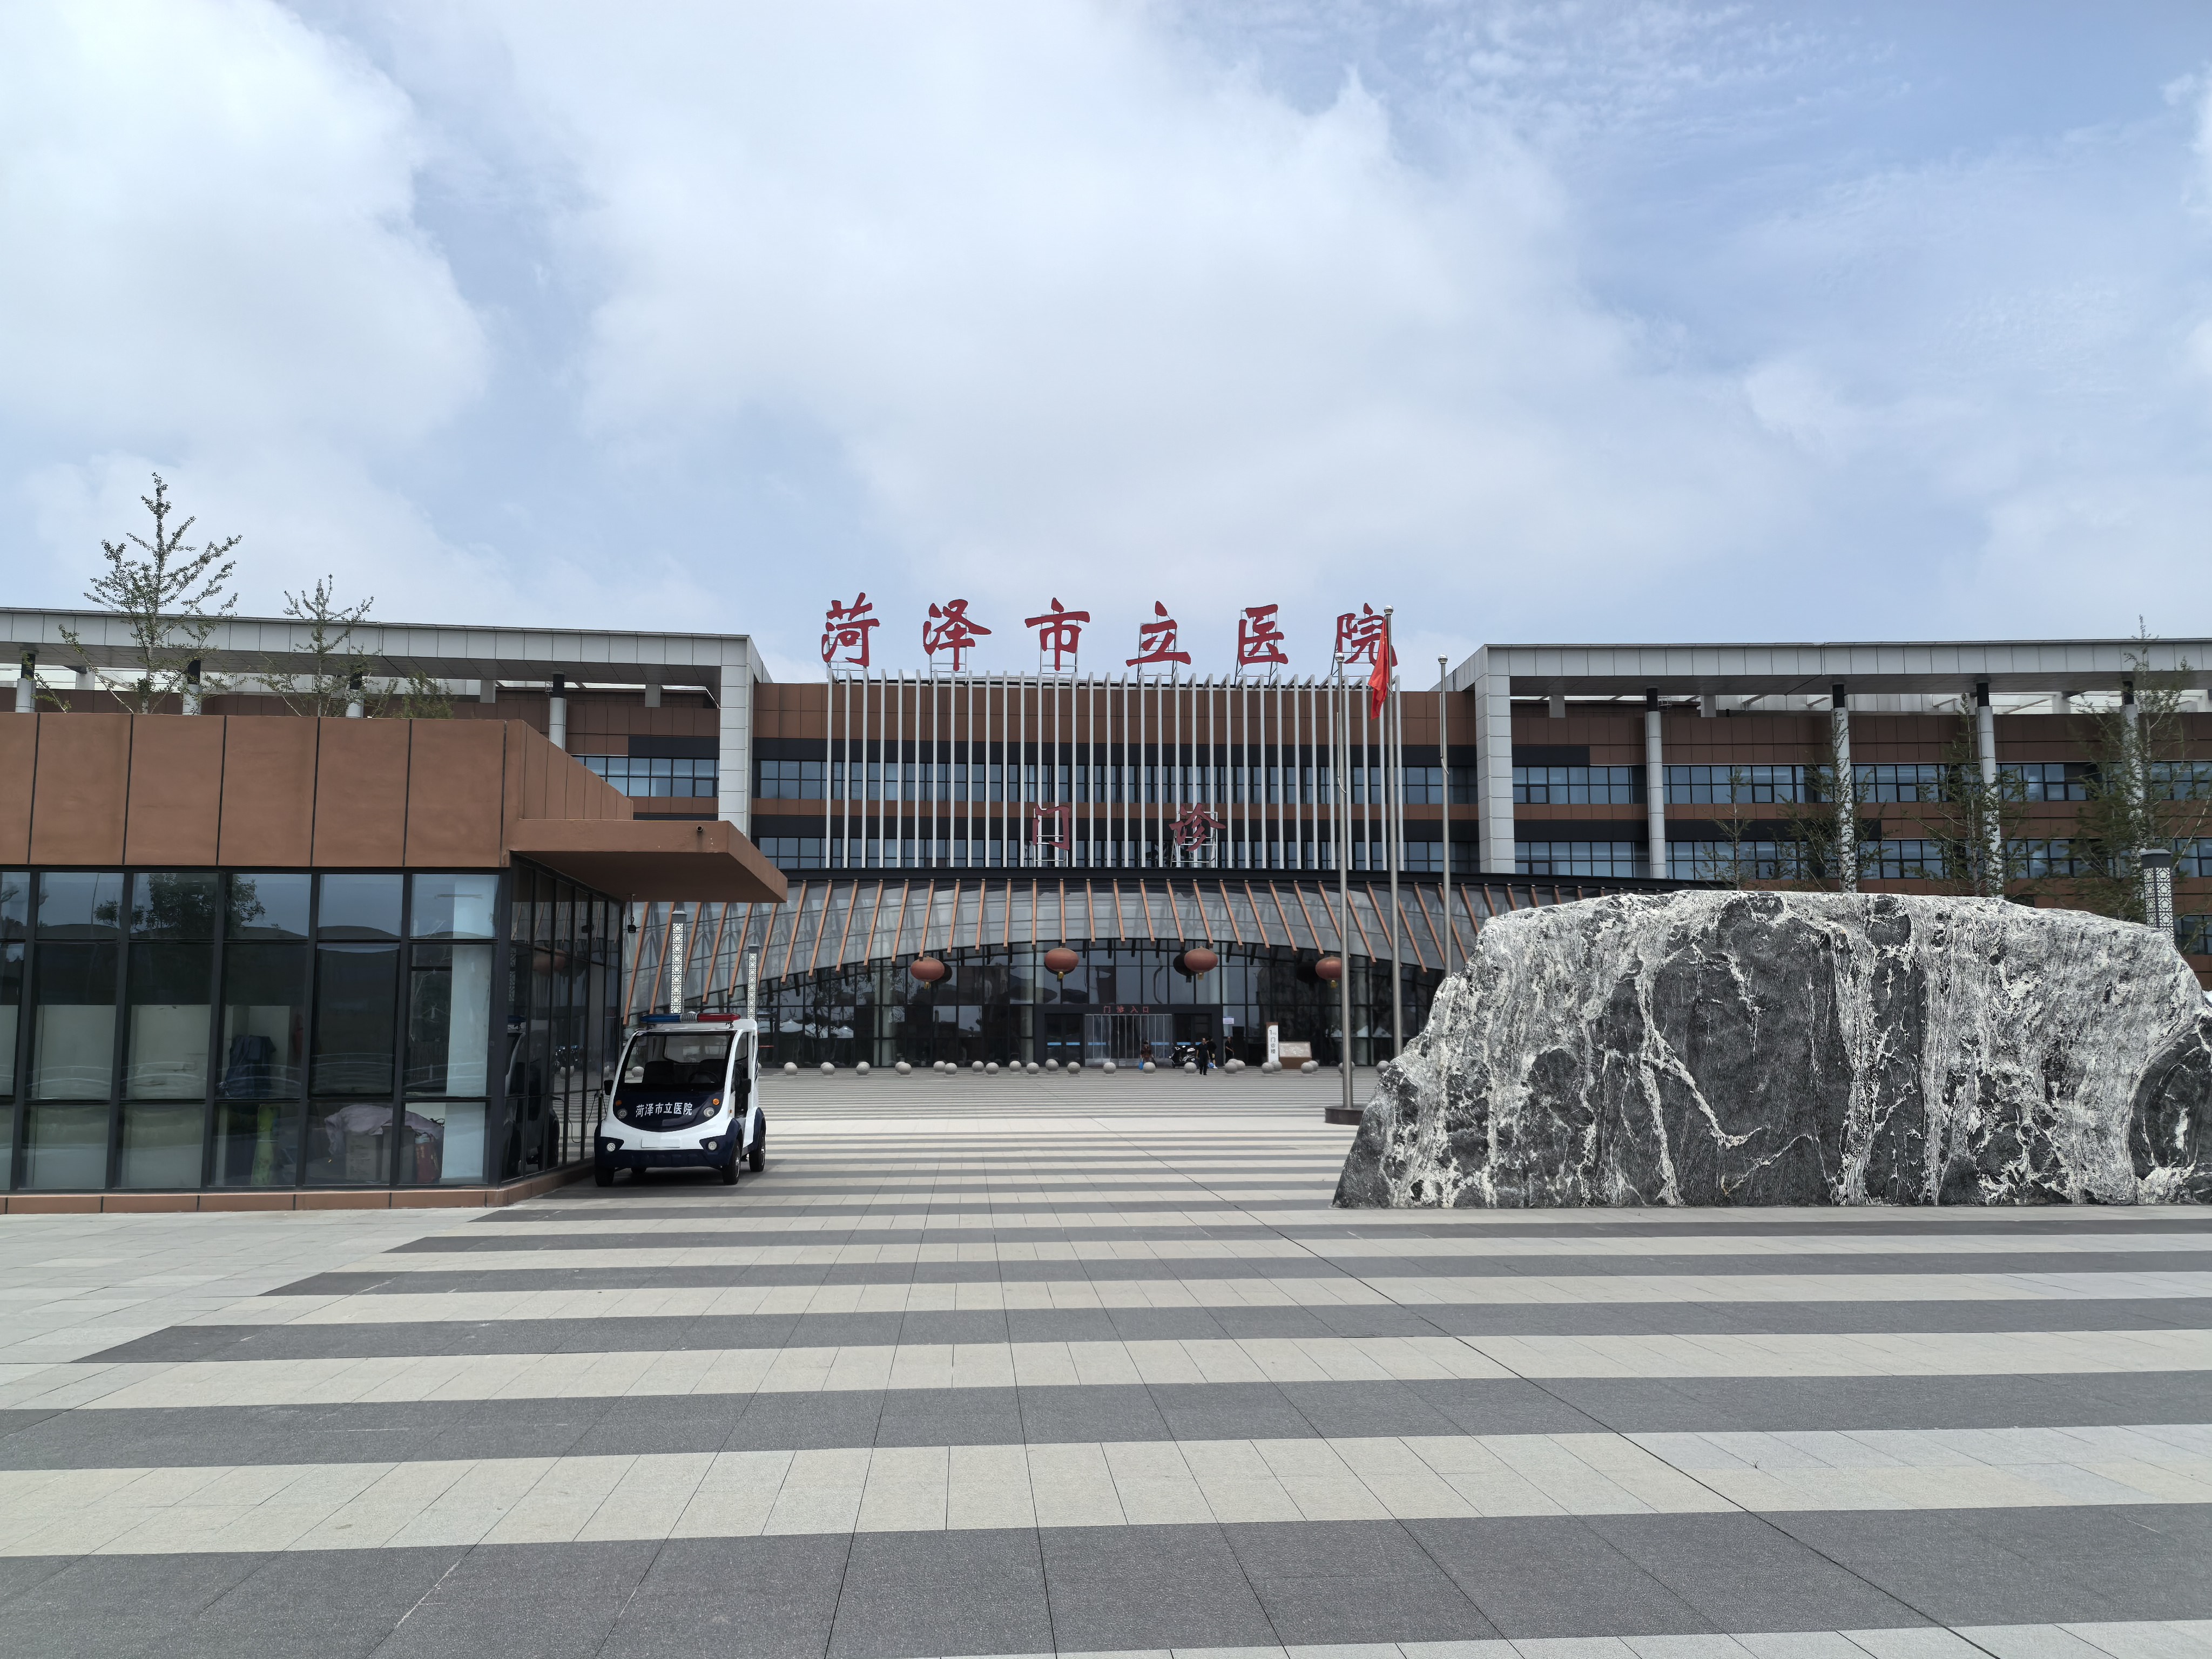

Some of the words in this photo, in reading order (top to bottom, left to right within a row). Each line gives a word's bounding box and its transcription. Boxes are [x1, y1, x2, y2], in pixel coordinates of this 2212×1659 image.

[822, 592, 1398, 671] 菏泽市立医院
[1033, 802, 1226, 852] 门诊
[636, 1102, 692, 1118] 菏泽市立医院
